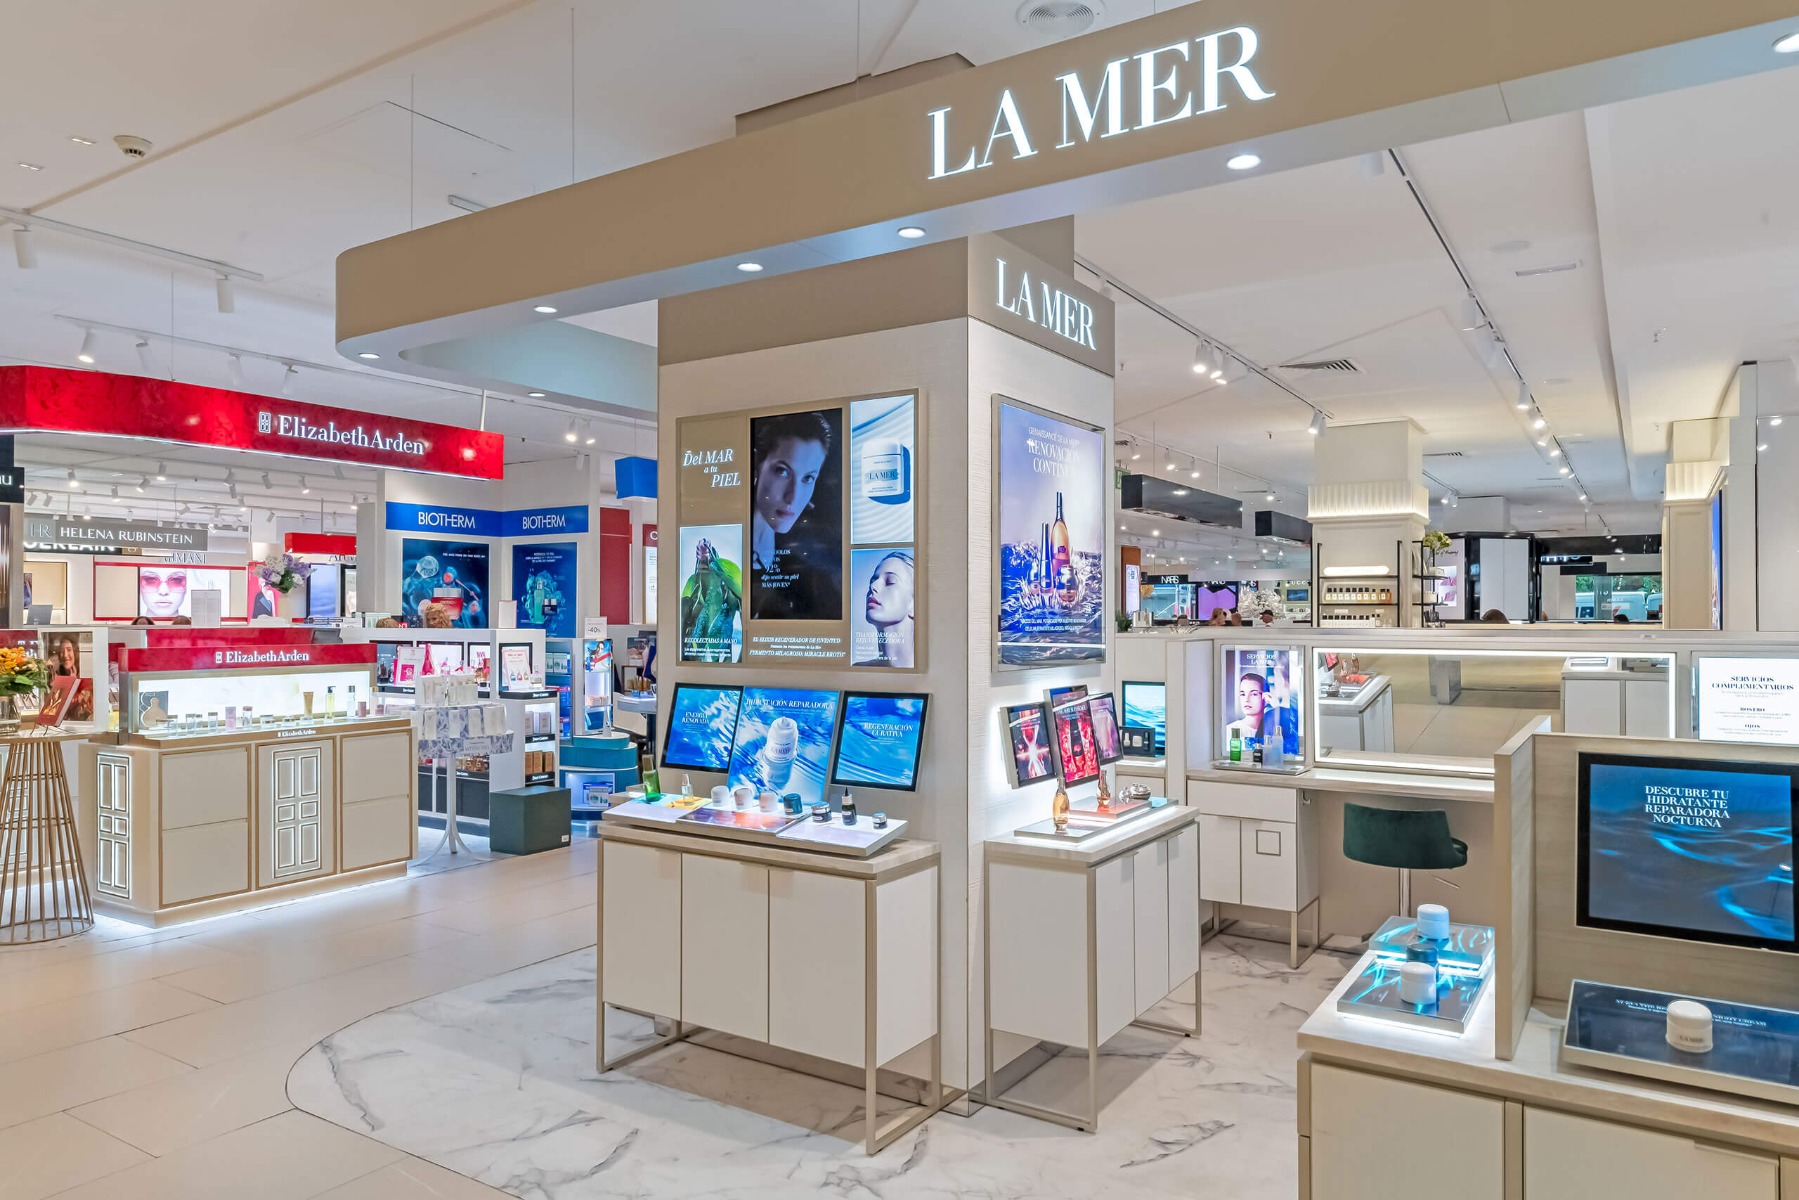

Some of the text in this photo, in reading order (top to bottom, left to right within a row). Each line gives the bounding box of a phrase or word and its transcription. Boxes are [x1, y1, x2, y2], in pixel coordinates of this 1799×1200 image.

[927, 25, 1276, 180] LA MER
[996, 258, 1097, 351] LA MER
[705, 449, 733, 464] MAR
[711, 472, 741, 488] PIEL
[880, 471, 896, 479] MER
[418, 511, 476, 529] BIOTHERM
[522, 514, 566, 530] BIOTHERM
[60, 526, 193, 544] HELENA RUBINSTEIN
[1161, 576, 1179, 584] NARS
[1645, 785, 1729, 800] DESCUBRE TU
[1647, 795, 1728, 809] HIDRATANTE
[1645, 804, 1730, 818] REPARADORA
[1653, 814, 1722, 828] NOCTURNA
